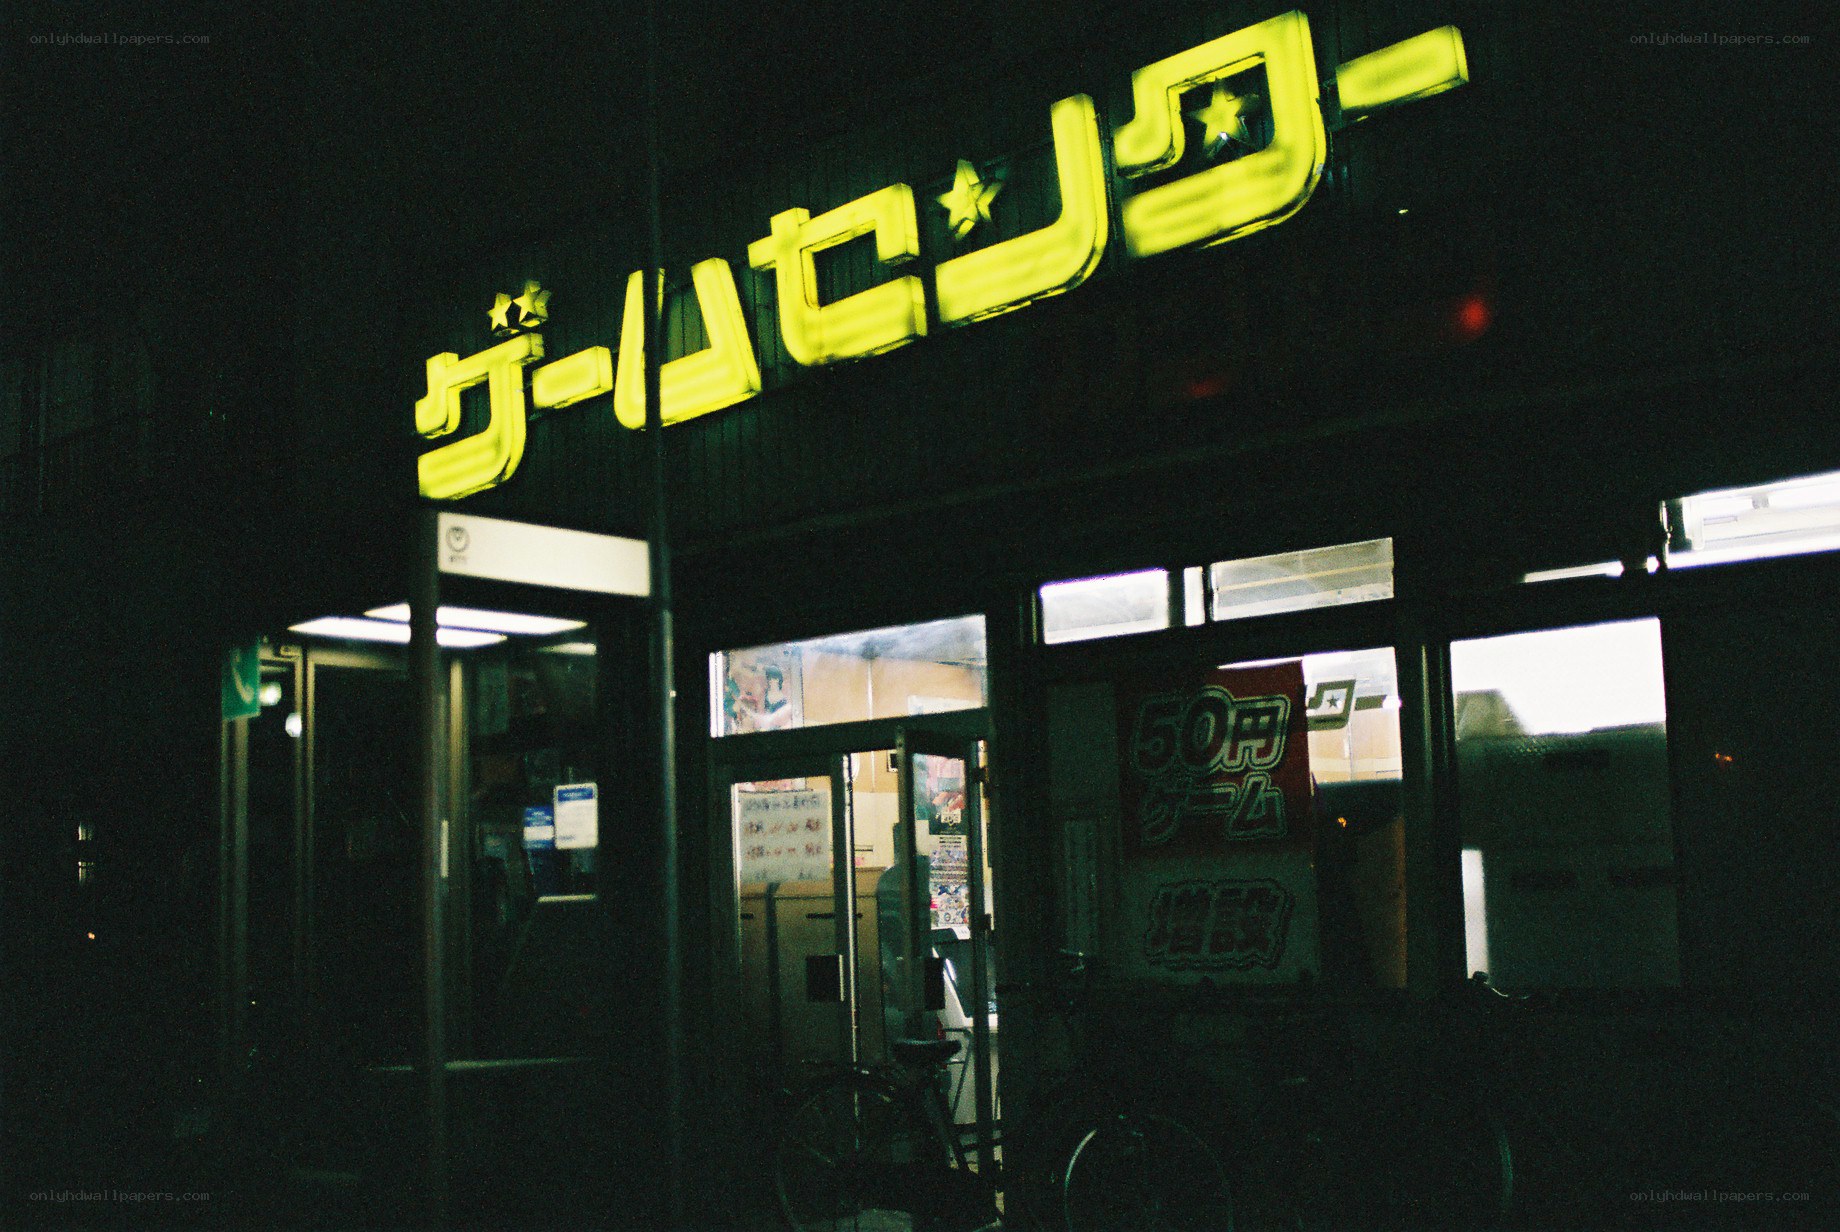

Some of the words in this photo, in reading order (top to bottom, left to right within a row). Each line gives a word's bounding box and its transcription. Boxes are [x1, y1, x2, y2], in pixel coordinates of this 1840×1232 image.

[414, 9, 1469, 500] ゲームセンター
[1134, 686, 1290, 774] 50円
[1140, 772, 1288, 842] ゲーム
